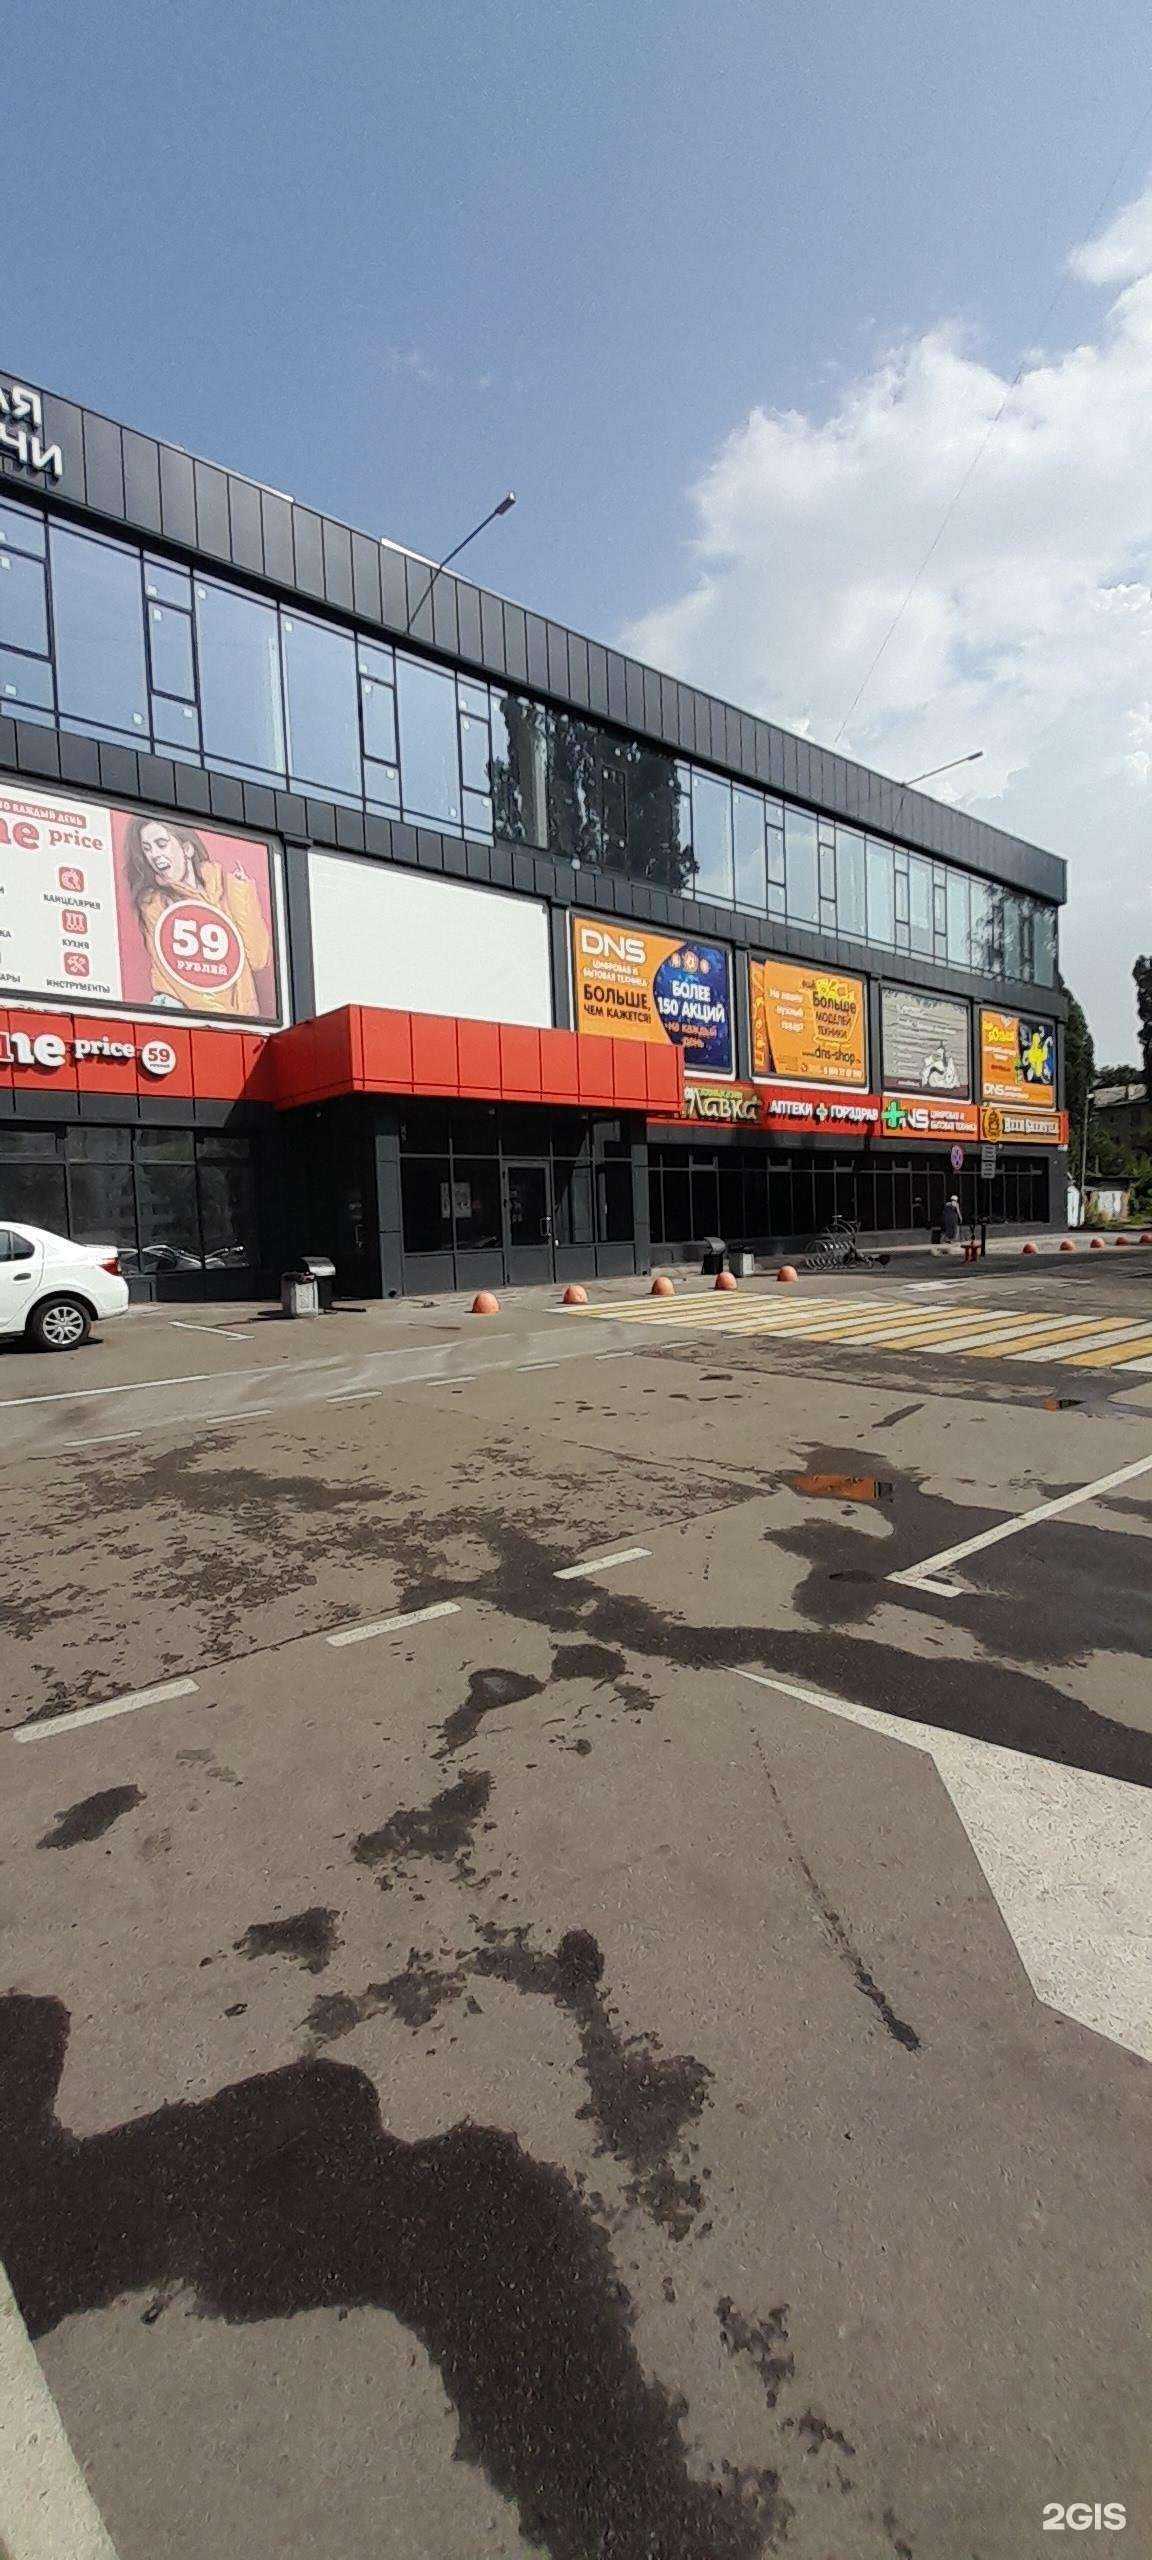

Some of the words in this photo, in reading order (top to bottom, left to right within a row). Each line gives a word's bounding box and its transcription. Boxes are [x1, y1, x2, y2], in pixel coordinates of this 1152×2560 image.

[0, 386, 42, 427] Я
[48, 828, 104, 851] price
[43, 893, 101, 910] КАНЦЕЛЯРИЯ
[172, 918, 229, 961] 59
[581, 928, 646, 965] DNS
[583, 983, 652, 1012] БОЛЬШЕ,
[672, 980, 711, 1002] БОЛЕЕ
[583, 1003, 605, 1017] ЧЕМ
[681, 1002, 726, 1024] АКЦИЙ
[73, 1035, 136, 1059] price
[148, 1047, 171, 1063] 59
[769, 1099, 813, 1117] АПТЕКИ
